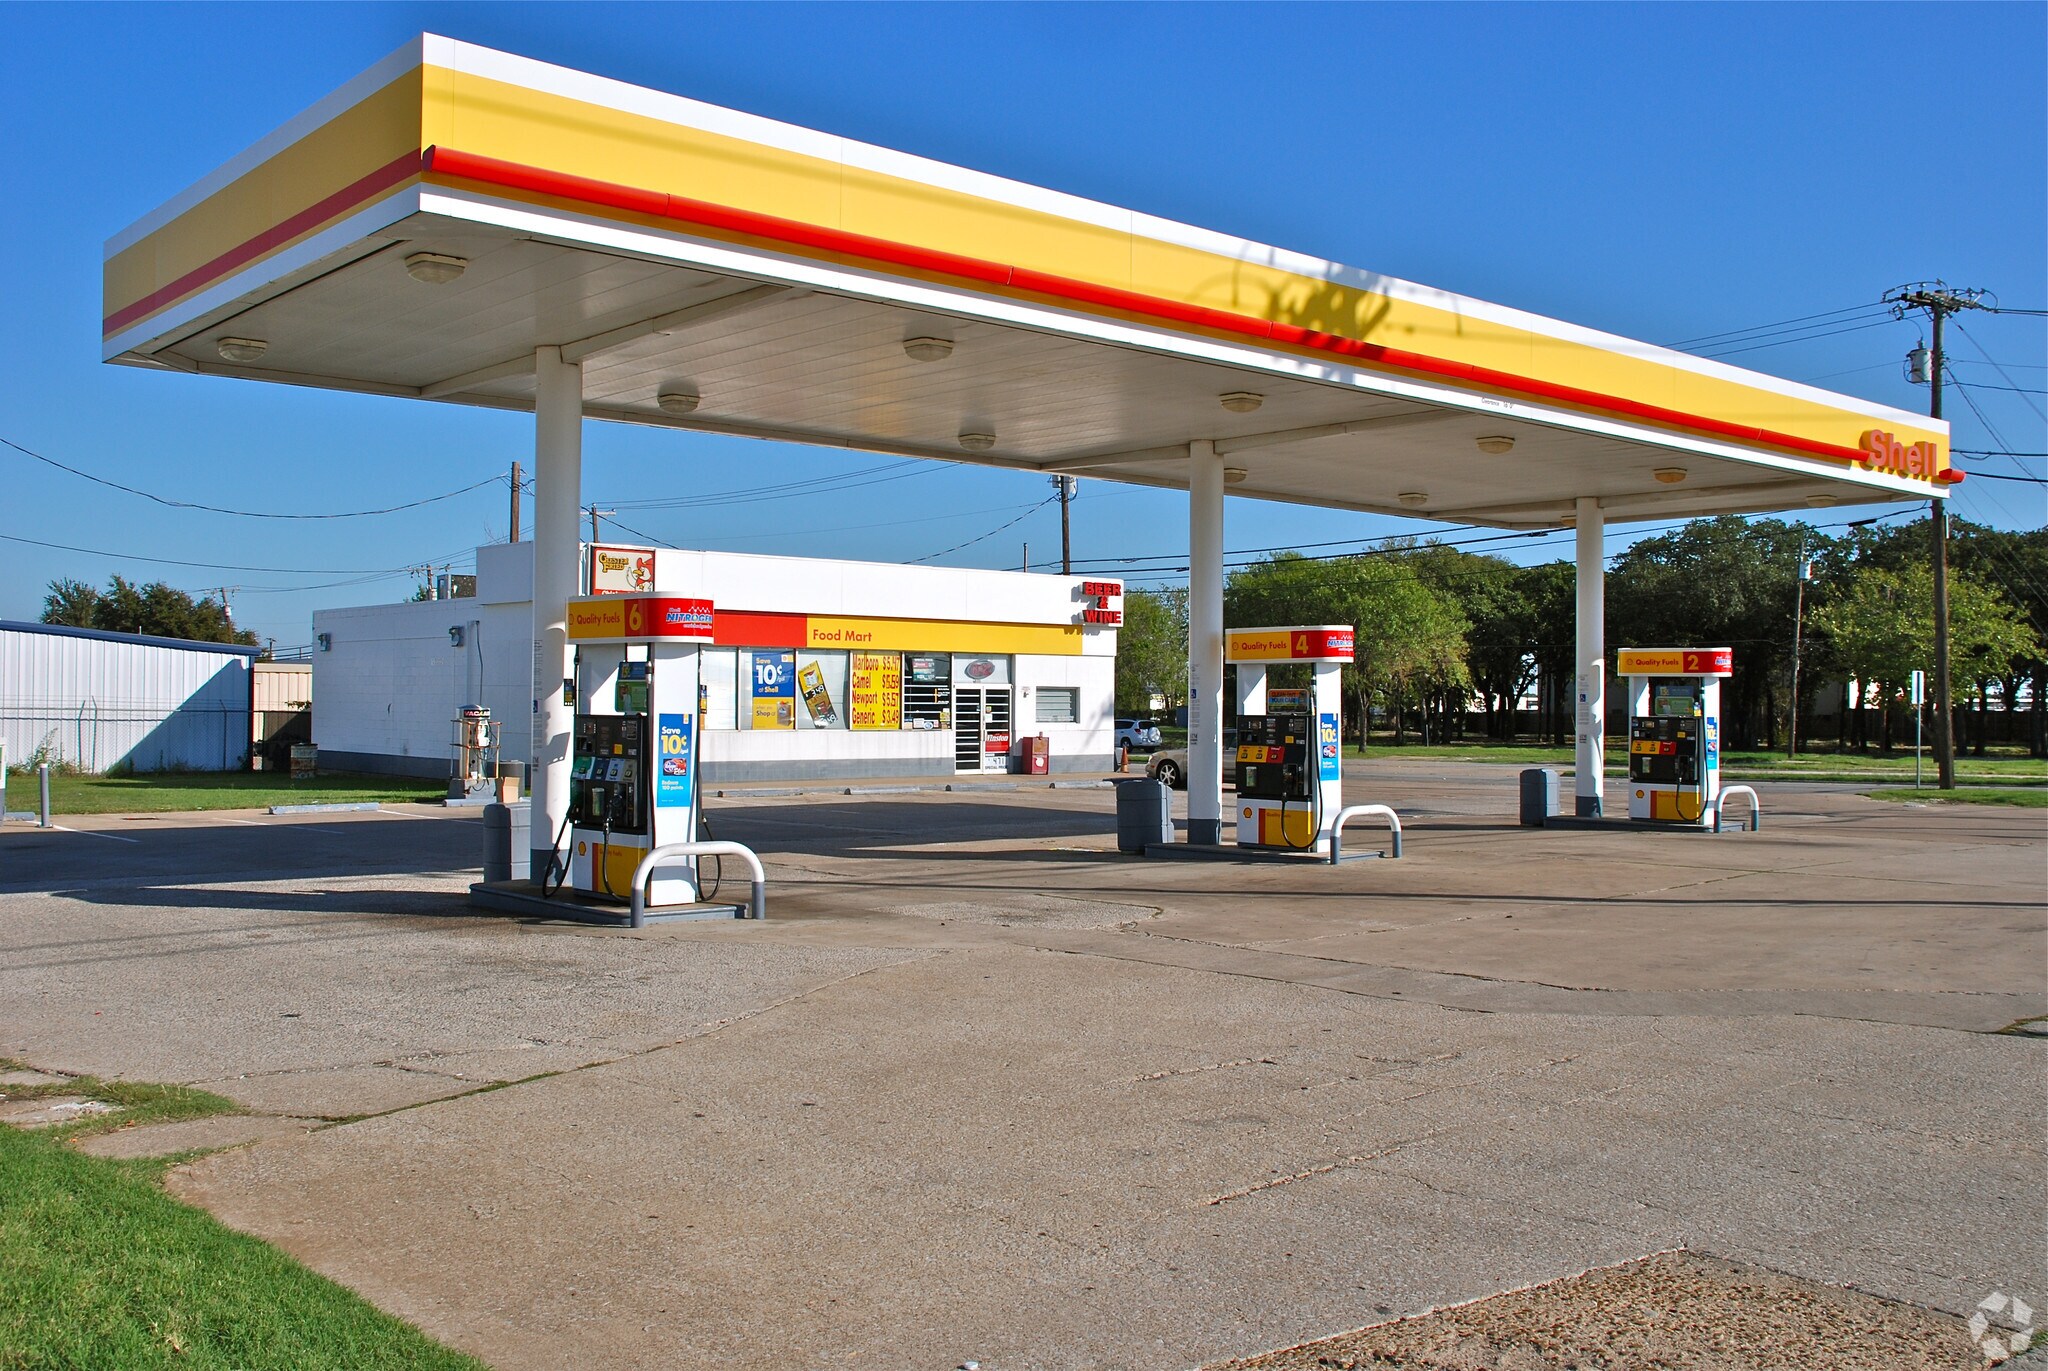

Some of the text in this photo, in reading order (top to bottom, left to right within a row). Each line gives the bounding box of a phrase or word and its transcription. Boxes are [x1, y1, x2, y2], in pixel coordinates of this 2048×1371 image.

[1859, 429, 1937, 476] Shell
[1082, 582, 1121, 596] BEER
[1097, 596, 1108, 609] &
[576, 611, 621, 626] Quality Fuels
[629, 604, 642, 631] 6
[1082, 610, 1121, 624] WINE
[813, 629, 872, 642] Food Mart
[1241, 641, 1287, 652] Quality Fuels
[1296, 634, 1309, 654] 4
[852, 653, 879, 671] Marlboro
[1636, 658, 1660, 667] Quality
[1687, 654, 1699, 671] 2
[852, 672, 871, 689] Camel
[852, 690, 878, 708] Newport
[756, 709, 771, 717] Shop
[852, 707, 876, 724] Generic
[661, 726, 681, 735] Save
[661, 734, 687, 754] 10¢
